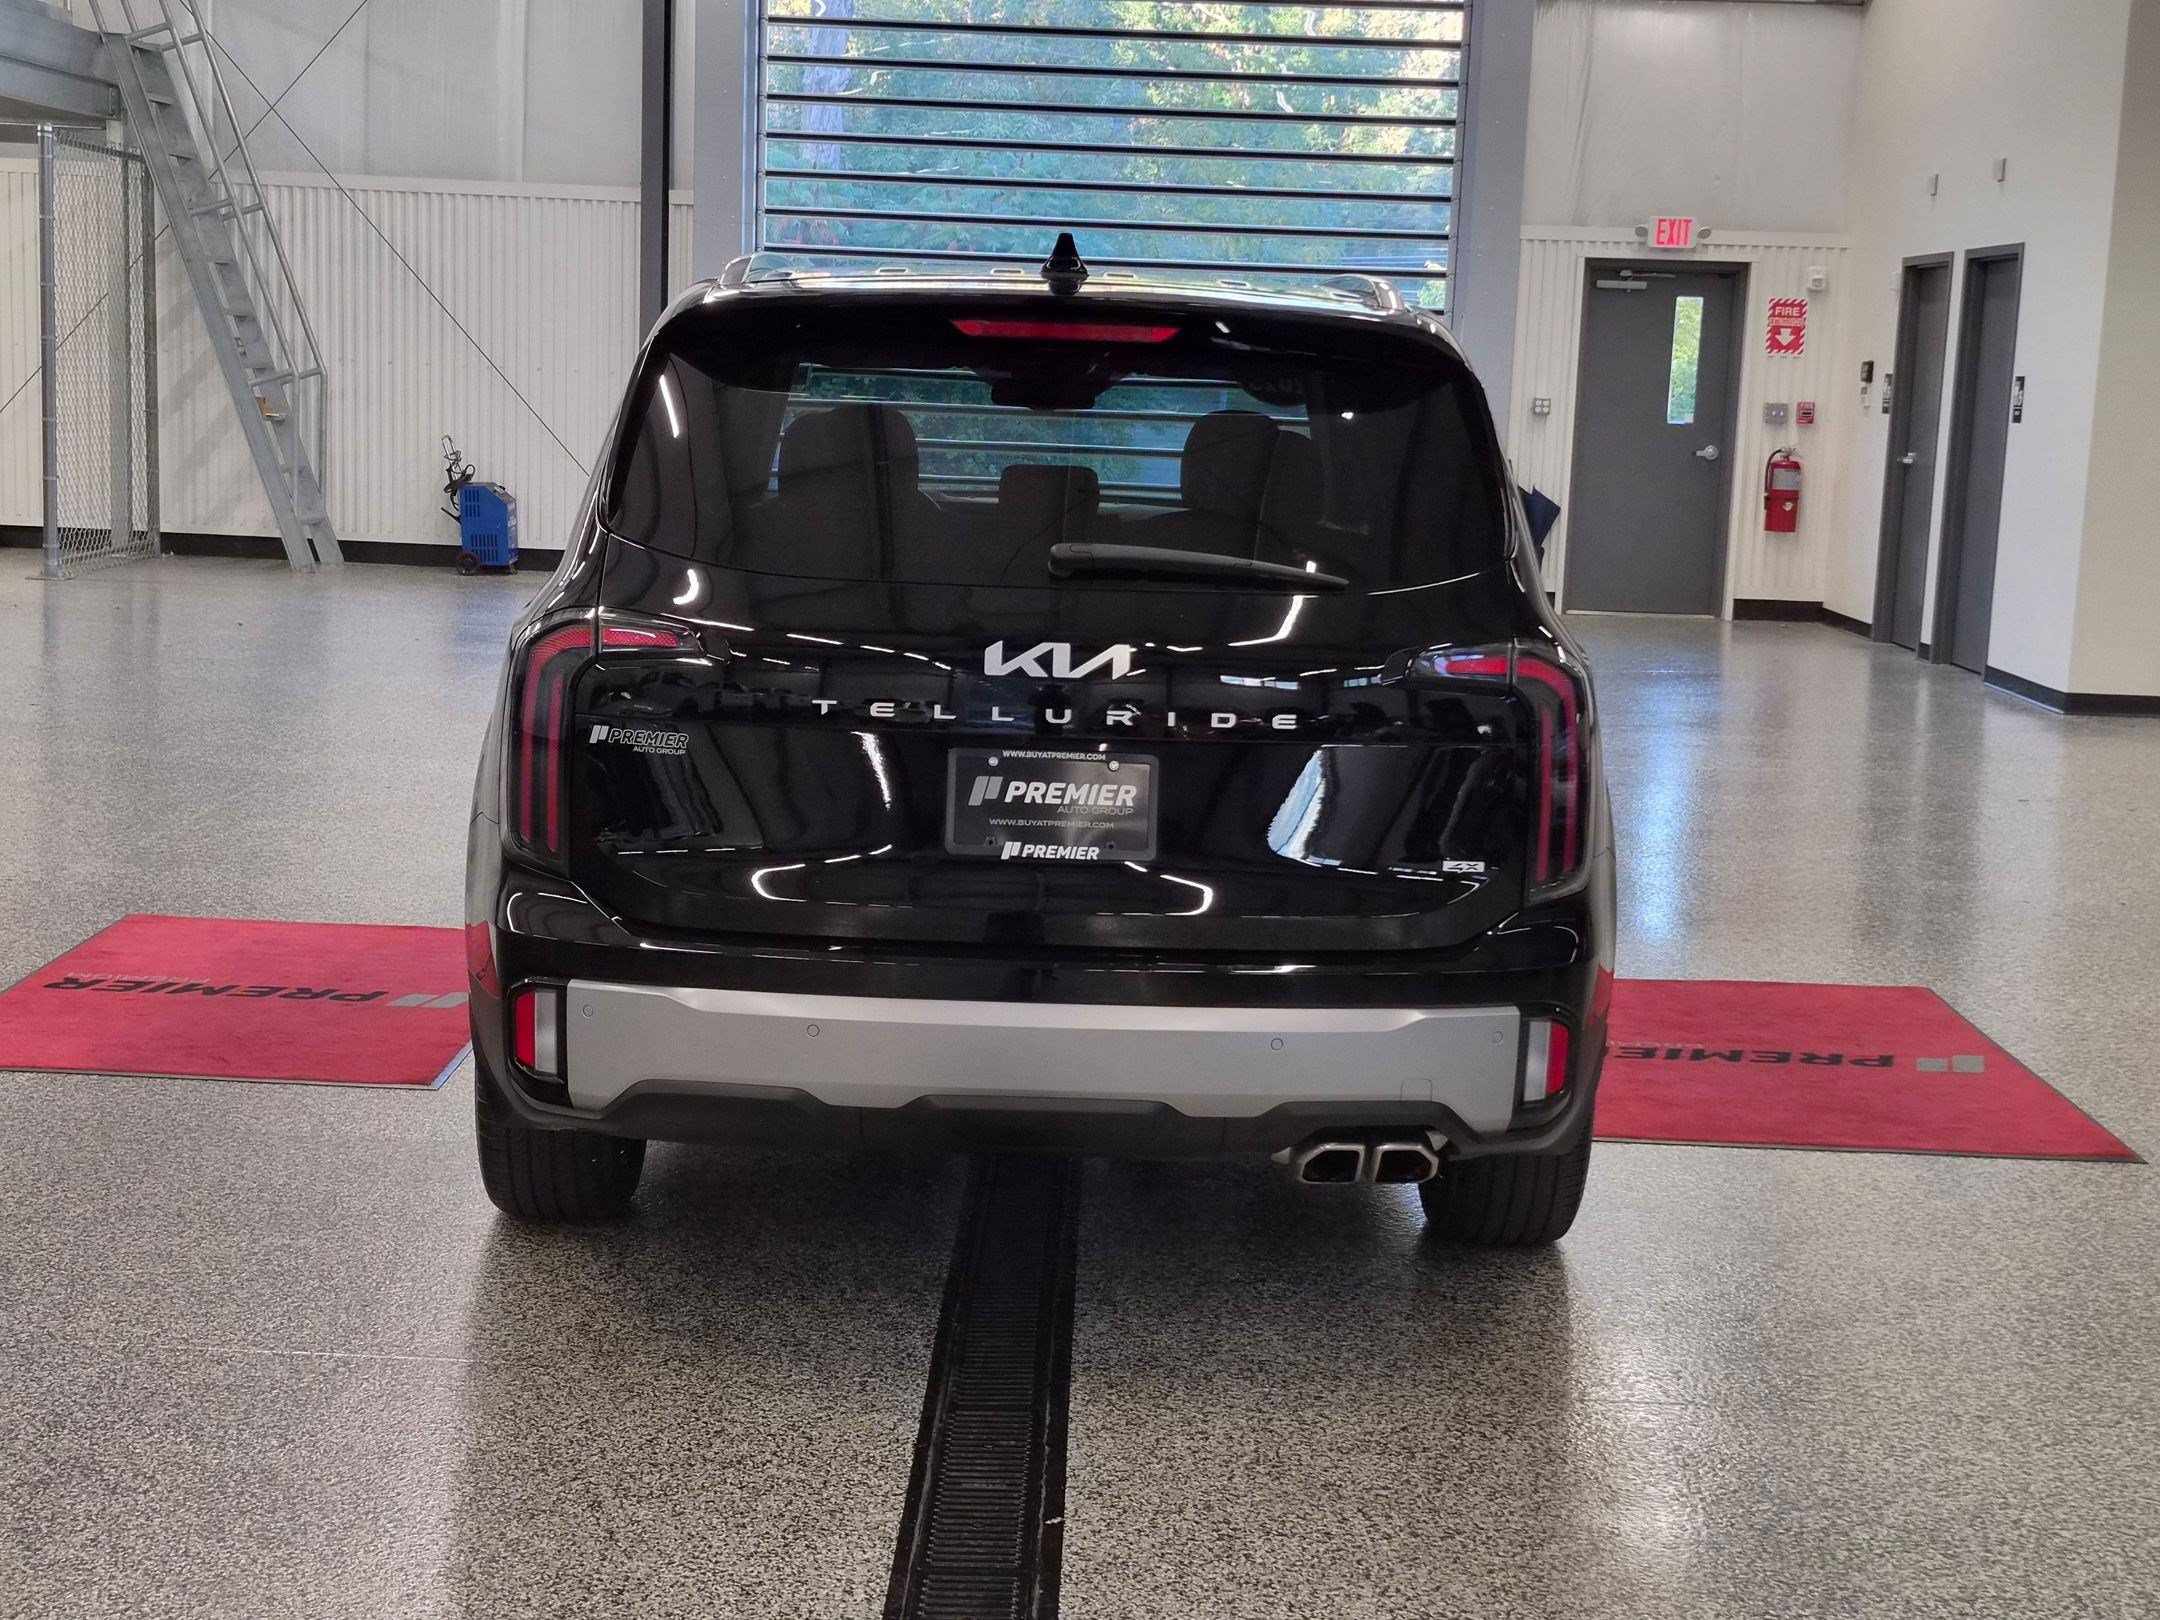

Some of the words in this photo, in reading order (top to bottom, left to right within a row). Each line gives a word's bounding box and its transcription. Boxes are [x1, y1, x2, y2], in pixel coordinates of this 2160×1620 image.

[1656, 219, 1692, 245] EXIT
[1775, 307, 1801, 316] FIRE
[984, 640, 1131, 680] KIA
[812, 699, 1298, 730] TELLURIDE
[608, 728, 689, 748] PREMIER
[633, 746, 655, 754] AUTO
[656, 747, 686, 755] GROUP
[1002, 750, 1106, 761] WWW.BUYATPREMIER.COM
[1004, 781, 1138, 806] PREMIER
[1057, 805, 1090, 815] AUTO
[1091, 806, 1134, 816] GROUP
[989, 818, 1115, 829] WWW.BUYATPREMIER.COM
[1022, 844, 1100, 860] PREMIER
[43, 977, 389, 1002] PREMIER
[1607, 1046, 1894, 1068] PREMIE
